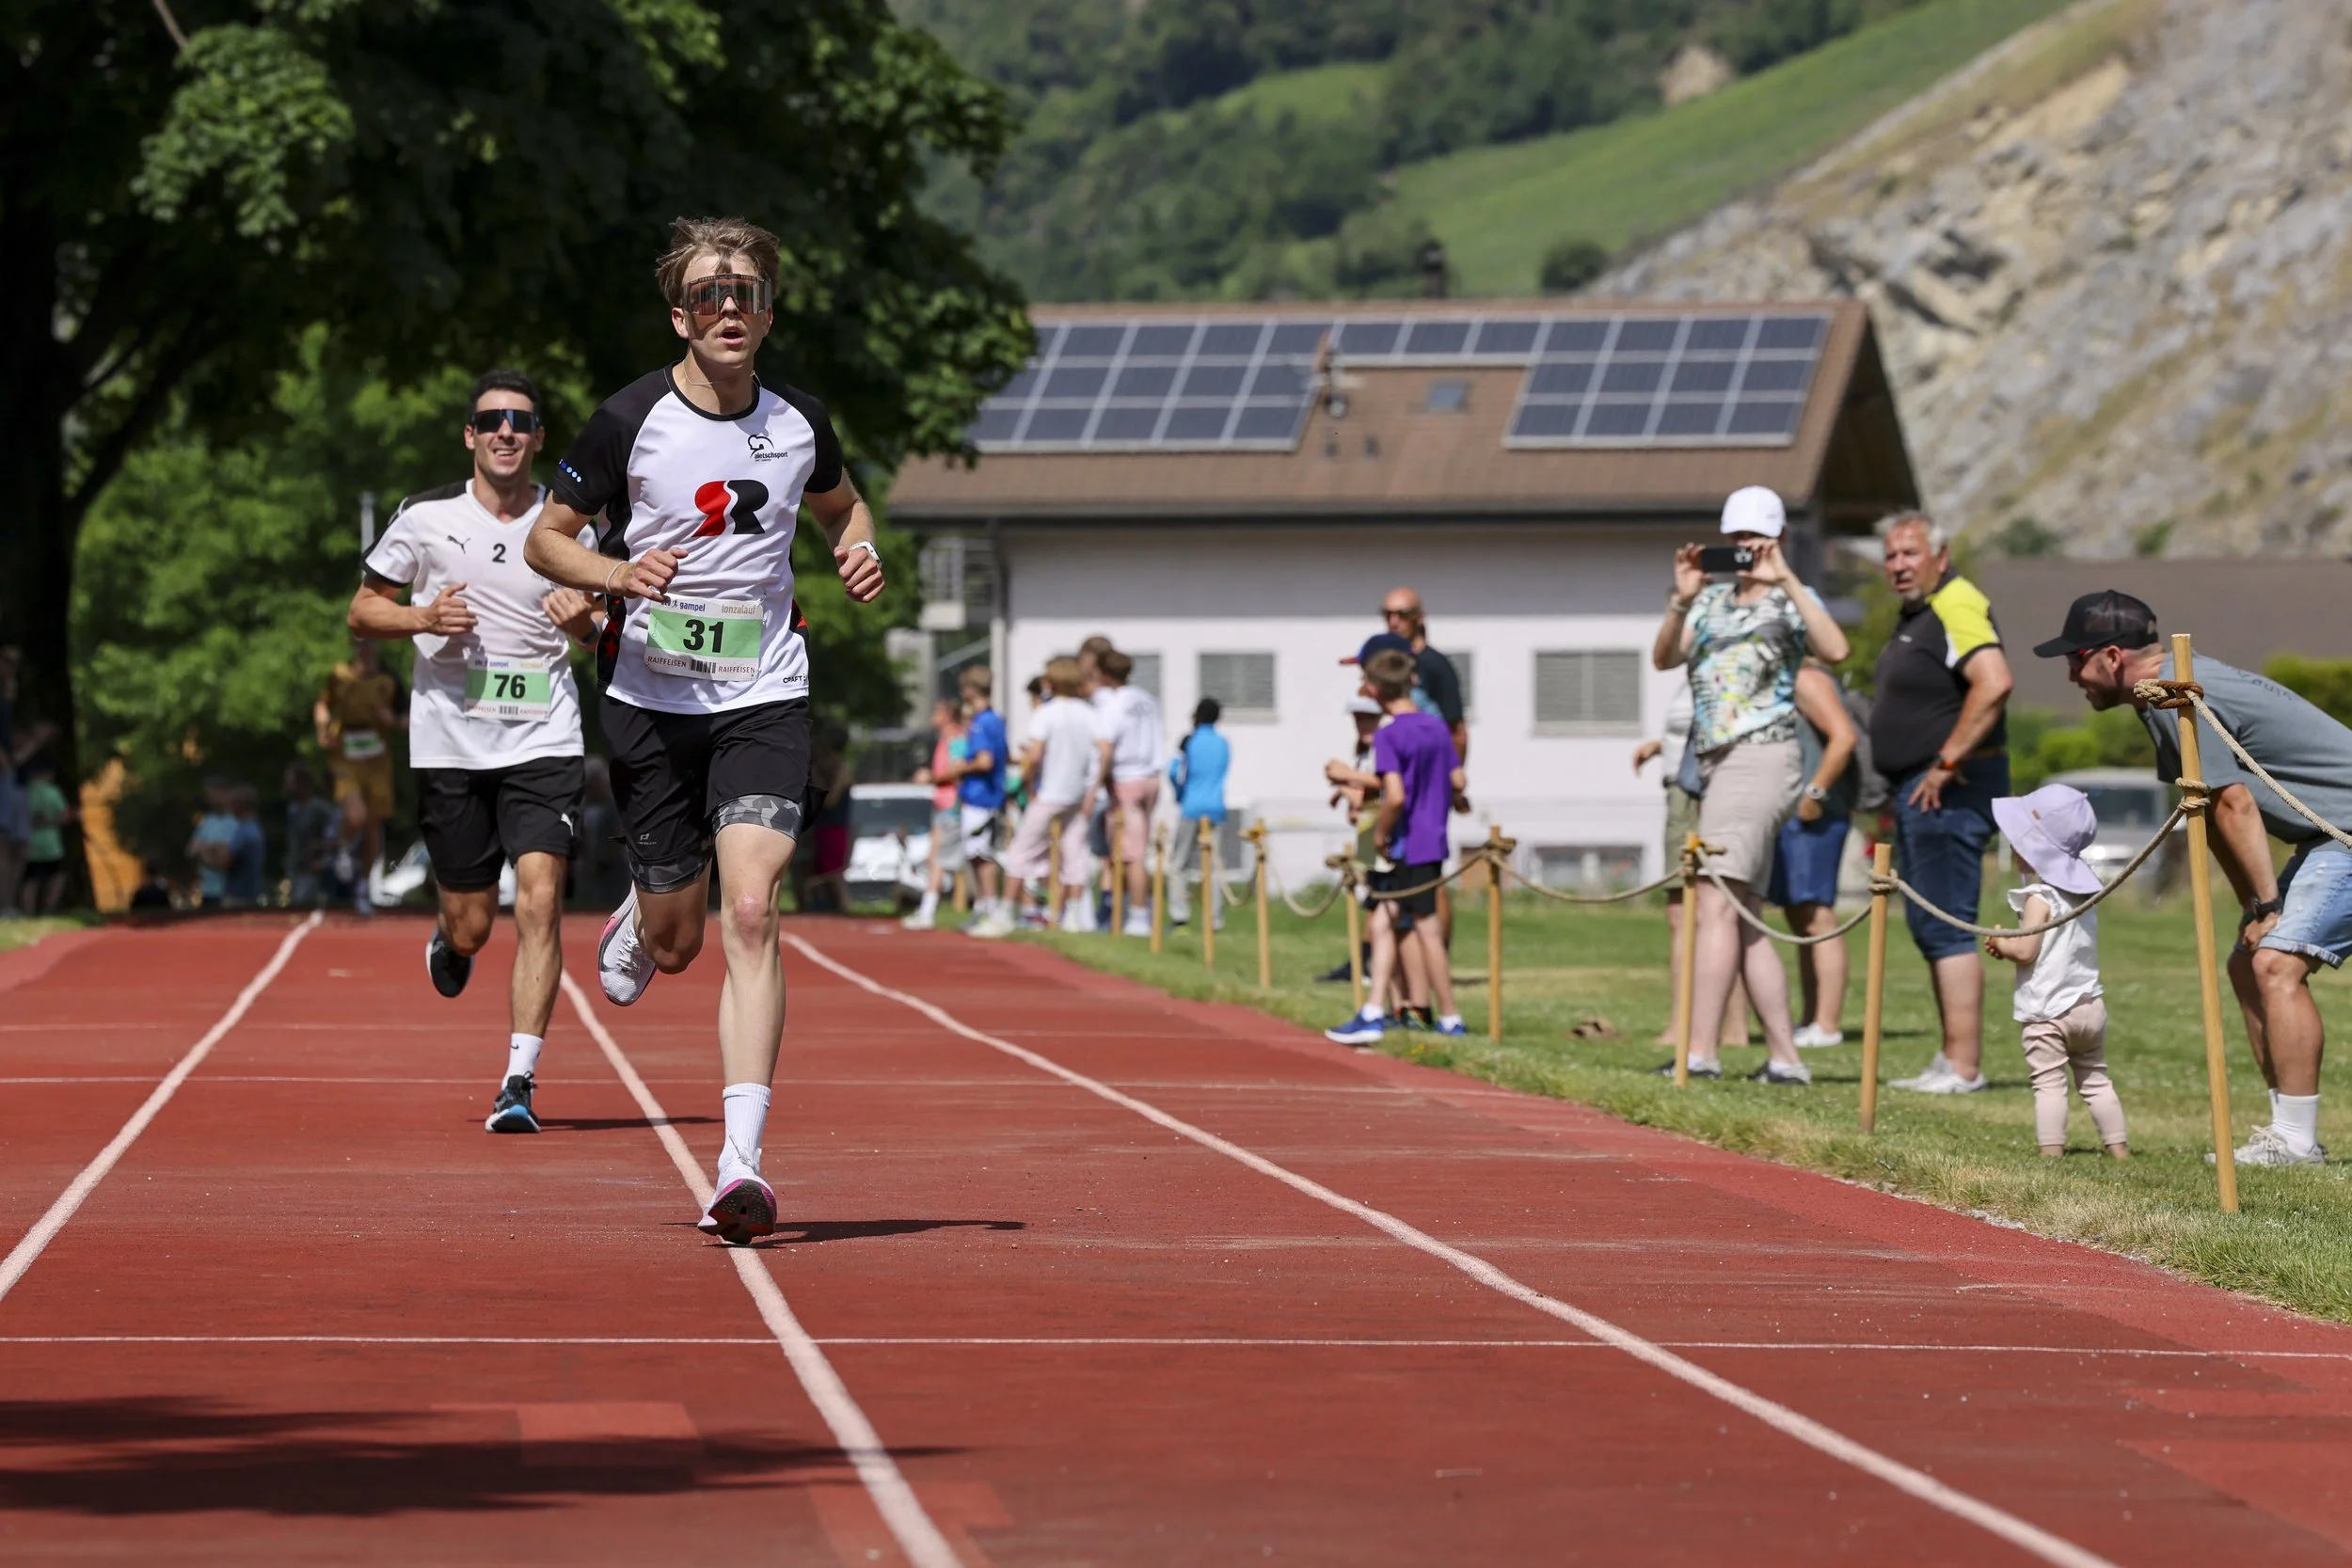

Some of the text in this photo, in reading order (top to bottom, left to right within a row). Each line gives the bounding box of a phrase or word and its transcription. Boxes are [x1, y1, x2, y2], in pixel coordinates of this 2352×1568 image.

[492, 543, 506, 563] 2
[679, 601, 706, 611] gampel
[722, 604, 756, 614] lonzalauf
[683, 619, 724, 653] 31
[647, 656, 687, 667] RAIFFEISEN
[494, 673, 526, 699] 76
